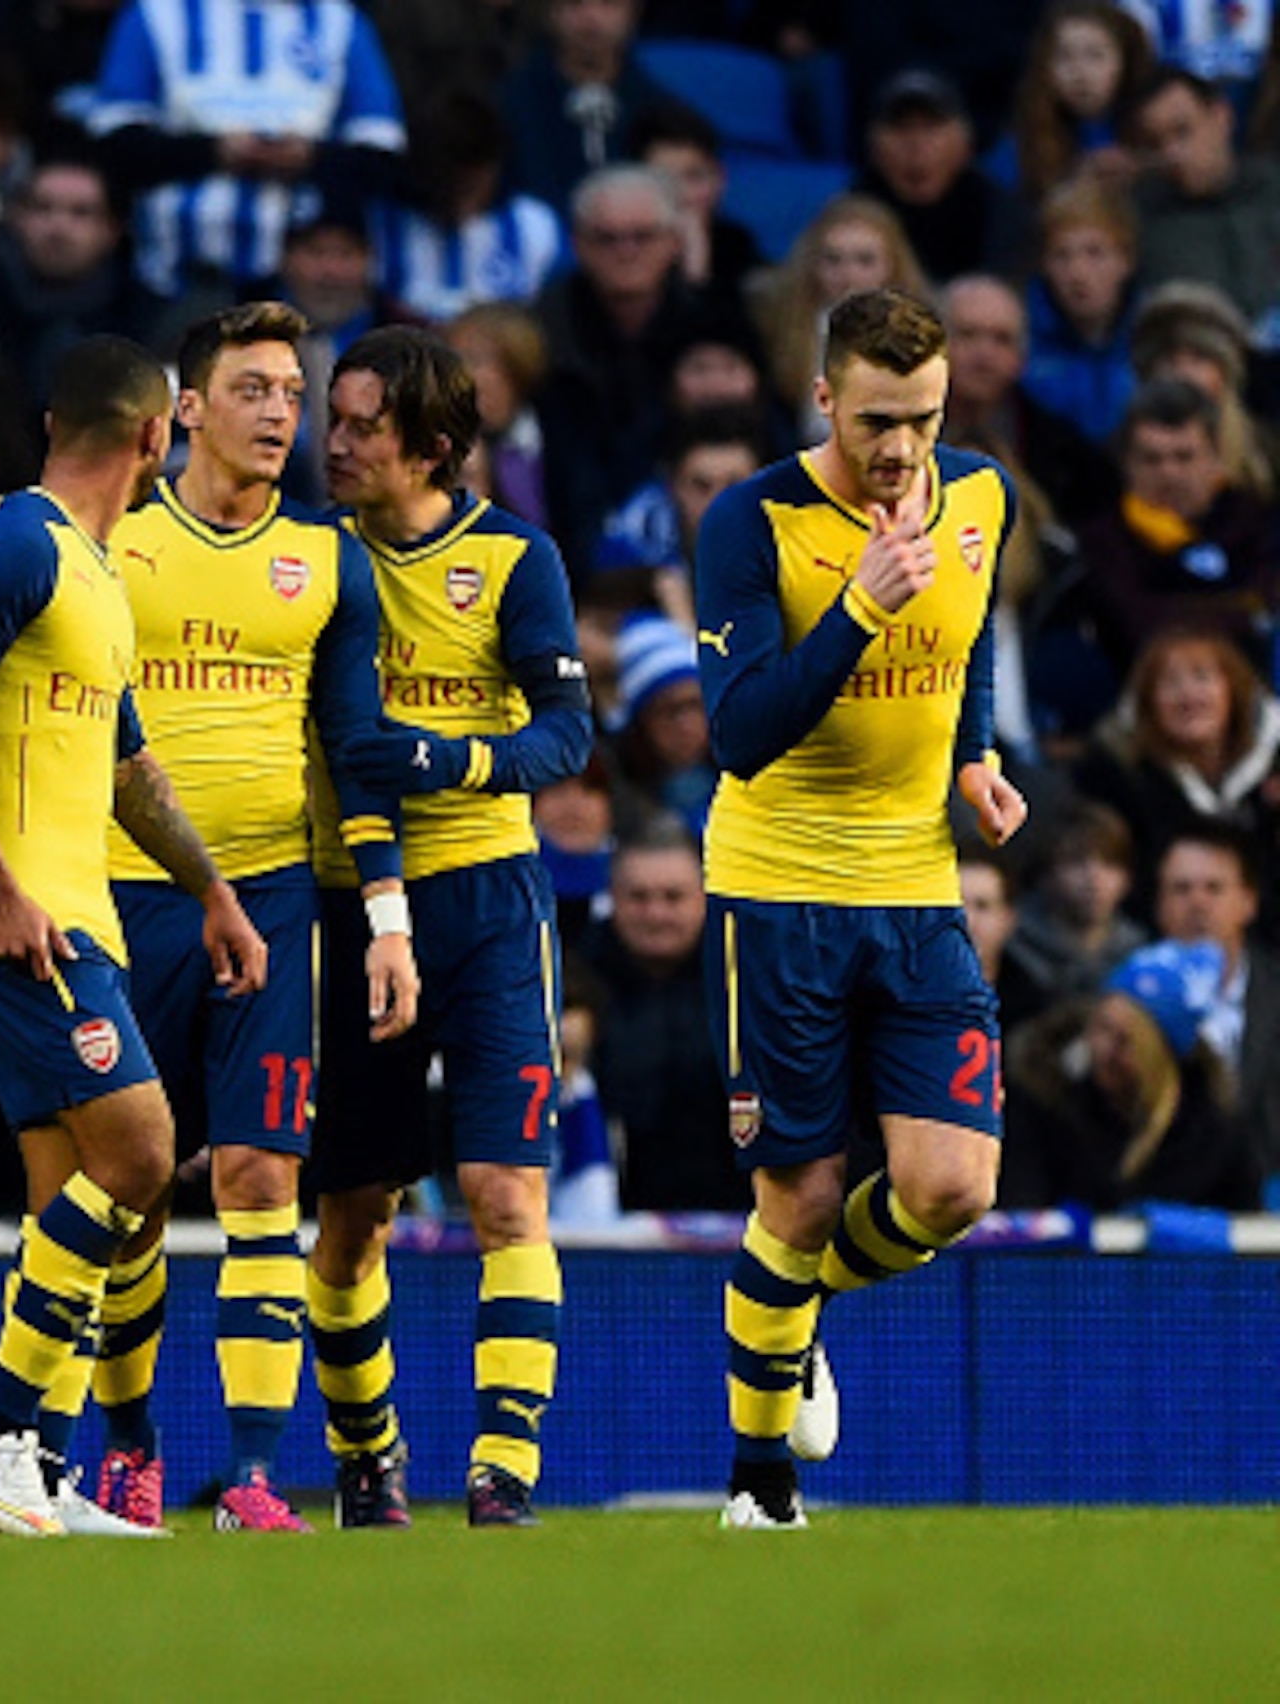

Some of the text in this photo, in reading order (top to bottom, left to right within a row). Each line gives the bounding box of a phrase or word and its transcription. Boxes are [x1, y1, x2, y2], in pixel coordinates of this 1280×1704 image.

[183, 618, 239, 654] Fly
[884, 623, 941, 654] Fly
[259, 1052, 313, 1136] 11
[518, 1063, 553, 1141] 7
